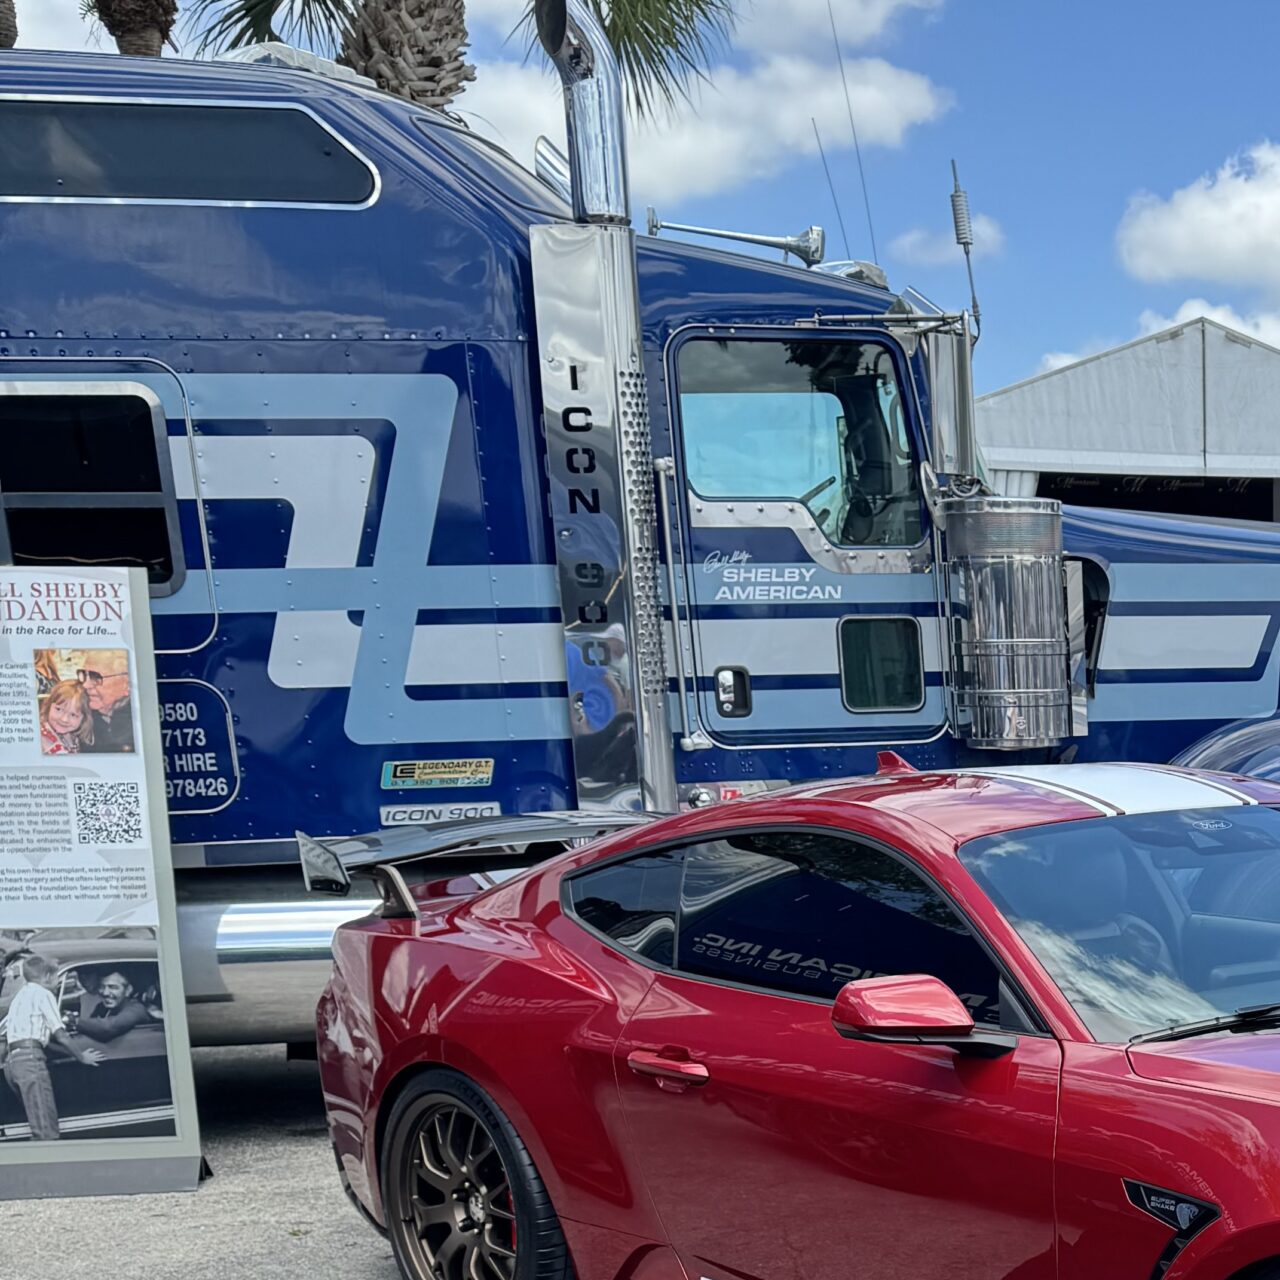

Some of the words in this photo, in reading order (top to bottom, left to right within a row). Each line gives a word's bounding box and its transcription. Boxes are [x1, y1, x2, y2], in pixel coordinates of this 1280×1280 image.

[562, 366, 600, 514] ICON
[722, 568, 817, 582] SHELBY
[30, 582, 123, 598] SHELBY
[715, 585, 841, 600] AMERICAN
[0, 600, 125, 621] DATION
[2, 626, 12, 635] in
[16, 625, 33, 635] the
[37, 626, 64, 635] Race
[68, 625, 83, 635] for
[175, 753, 218, 773] HIRE
[417, 761, 474, 770] LEGENDARY
[385, 809, 442, 822] ICON
[448, 807, 494, 820] 900
